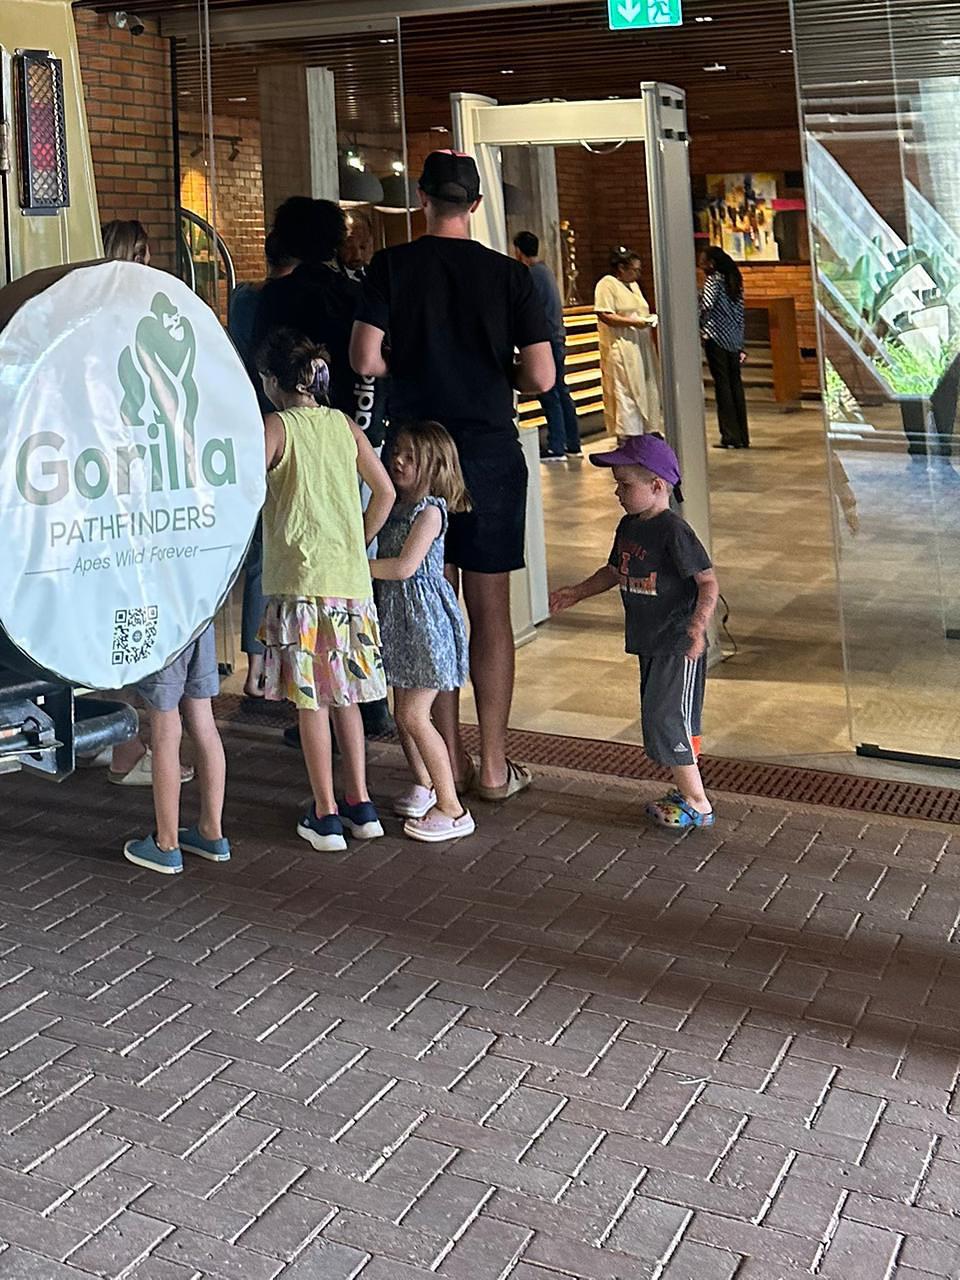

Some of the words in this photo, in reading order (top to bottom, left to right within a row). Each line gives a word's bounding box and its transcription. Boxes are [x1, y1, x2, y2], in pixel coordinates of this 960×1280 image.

[15, 422, 238, 506] Gorilla
[49, 504, 217, 548] PATHFINDERS
[72, 556, 112, 577] Apes
[115, 547, 145, 567] Wild
[149, 544, 200, 564] Forever
